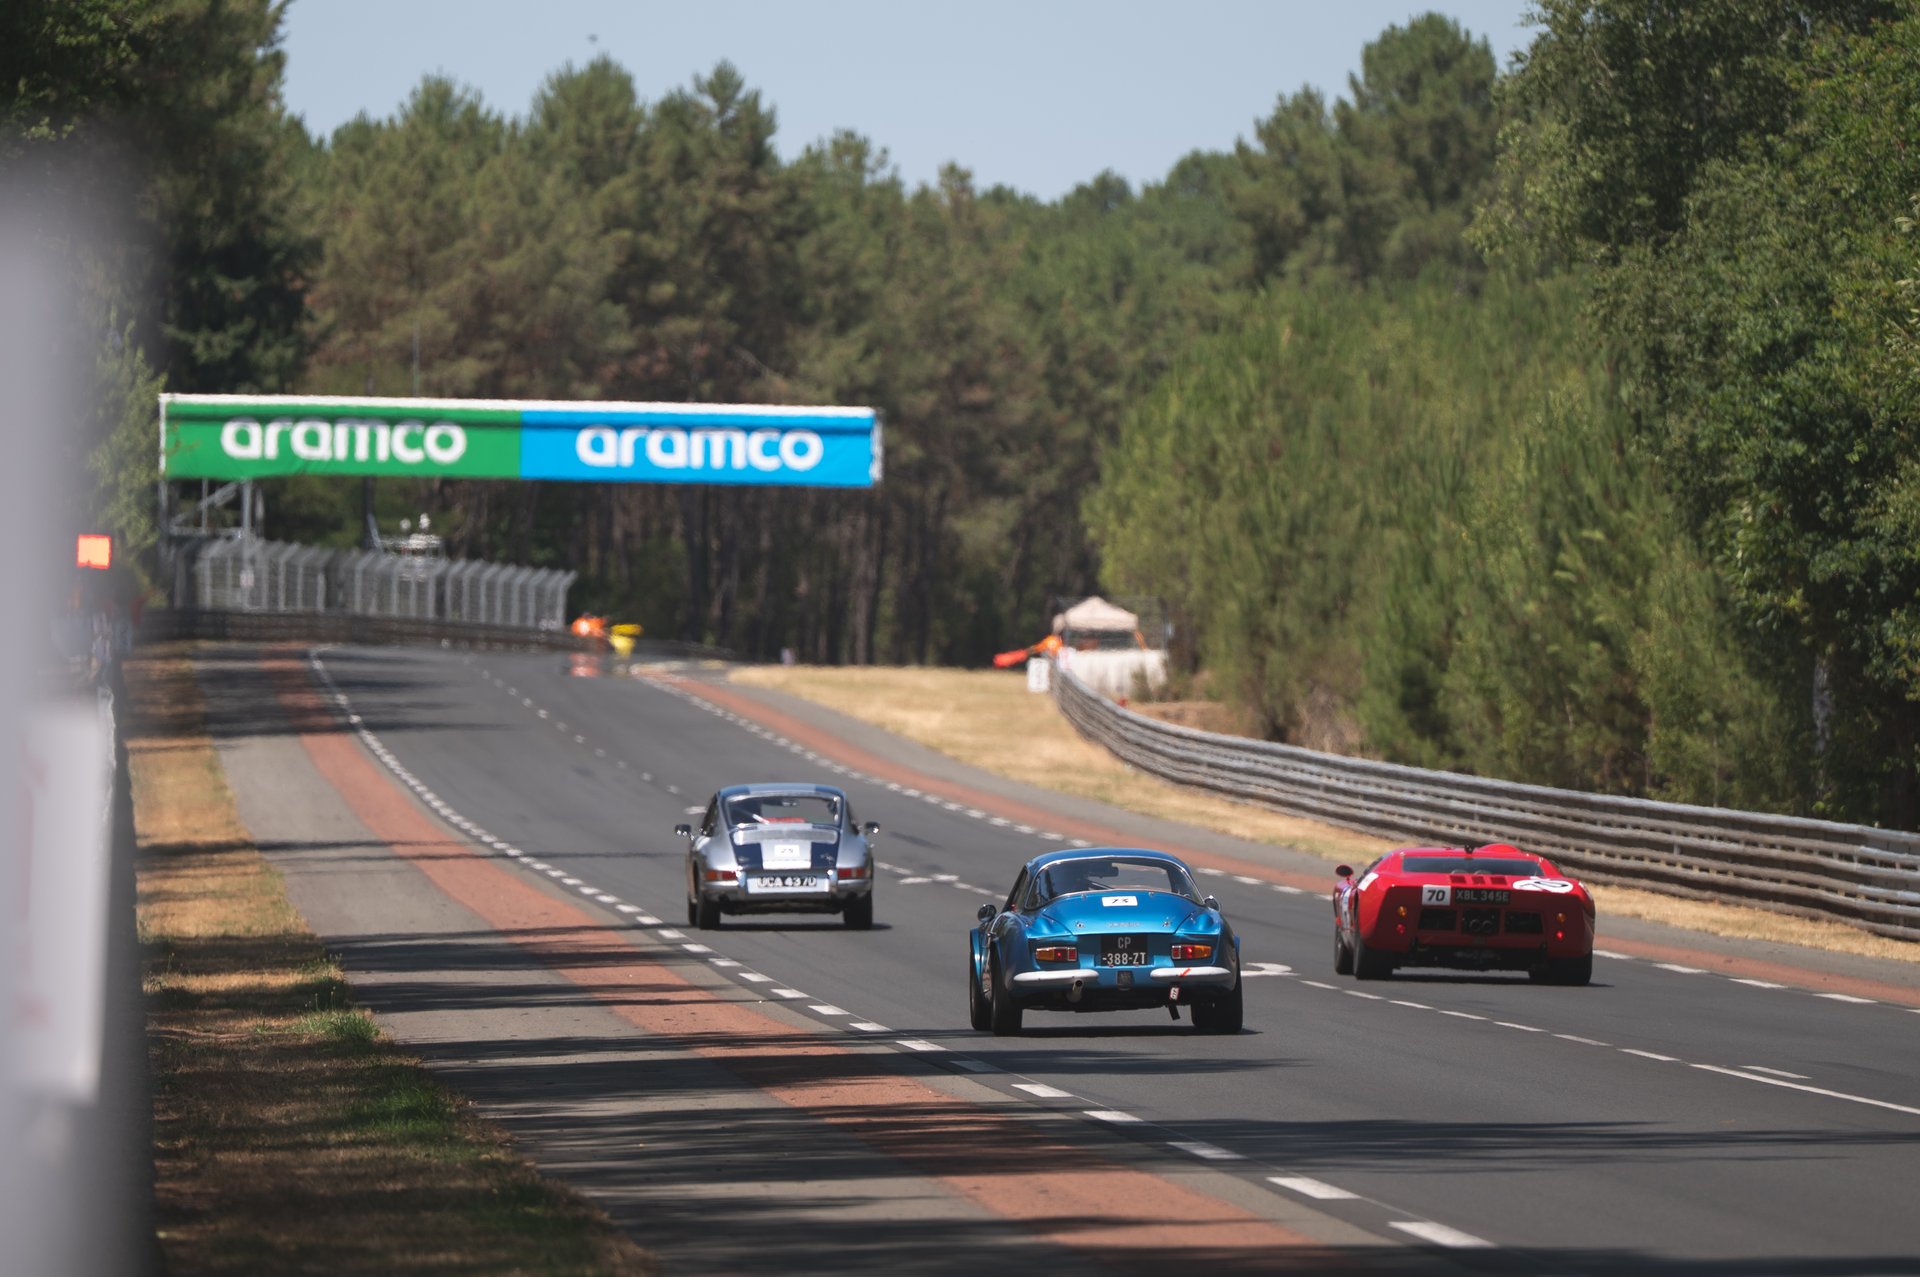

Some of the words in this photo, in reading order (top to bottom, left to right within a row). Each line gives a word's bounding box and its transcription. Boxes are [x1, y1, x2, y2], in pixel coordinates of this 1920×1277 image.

[220, 416, 467, 464] aramco
[575, 424, 824, 472] aramco
[1426, 889, 1446, 902] 70
[1455, 889, 1478, 901] XBL
[1480, 889, 1510, 902] 345E
[1117, 936, 1132, 949] CP
